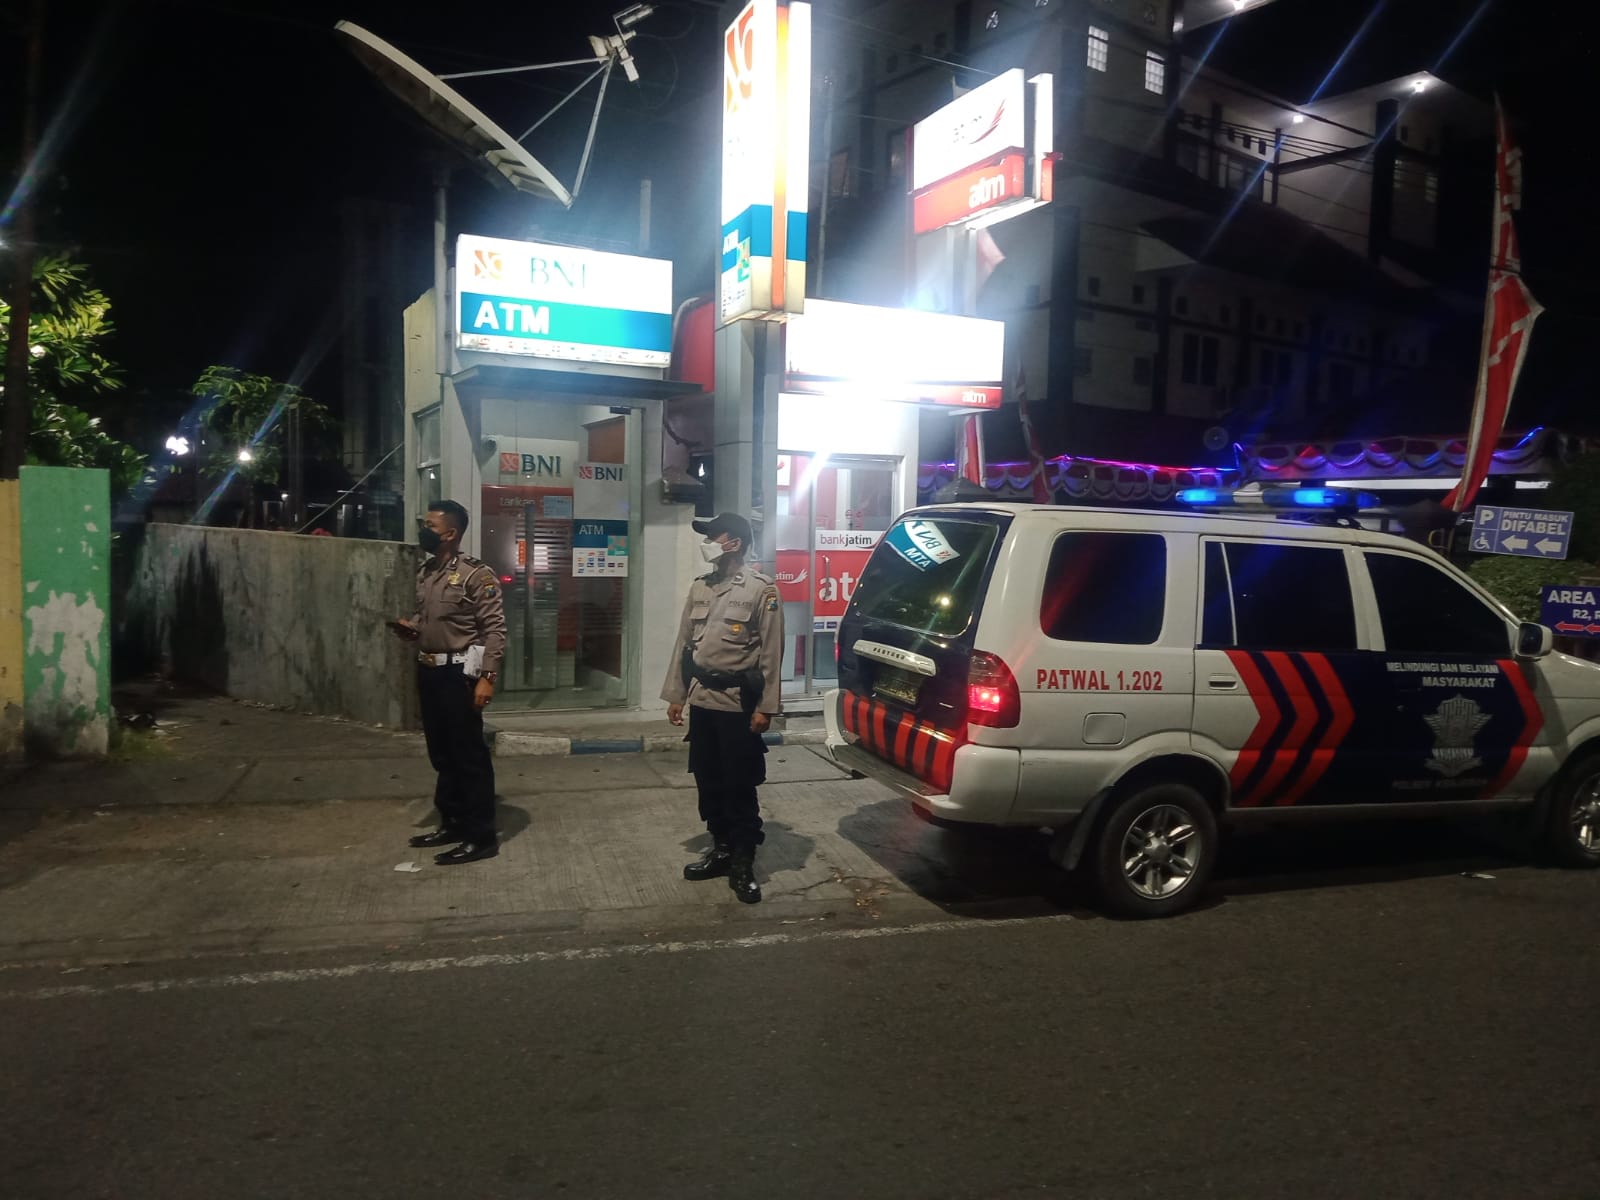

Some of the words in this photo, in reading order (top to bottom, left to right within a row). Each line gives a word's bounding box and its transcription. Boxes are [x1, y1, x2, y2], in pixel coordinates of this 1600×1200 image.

[968, 173, 1005, 208] atm
[530, 257, 586, 289] BNI
[473, 300, 549, 335] ATM
[961, 391, 986, 403] atm
[521, 454, 561, 475] BNI
[594, 466, 623, 481] BNI
[1480, 510, 1495, 525] P
[1503, 511, 1532, 520] PINTU
[1534, 513, 1568, 522] MASUK
[579, 525, 604, 535] ATM
[1501, 520, 1566, 535] DIFABEL
[820, 534, 872, 547] bankjatim
[819, 572, 860, 602] at
[1547, 590, 1596, 605] AREA
[1572, 609, 1592, 620] R2,
[1386, 662, 1440, 672] MELINDUNGI
[1441, 663, 1458, 673] DAN
[1459, 664, 1500, 674] MELAYANI
[1036, 669, 1110, 691] PATWAL
[1117, 671, 1163, 691] 1.202
[1422, 677, 1496, 688] MASYARAKAT
